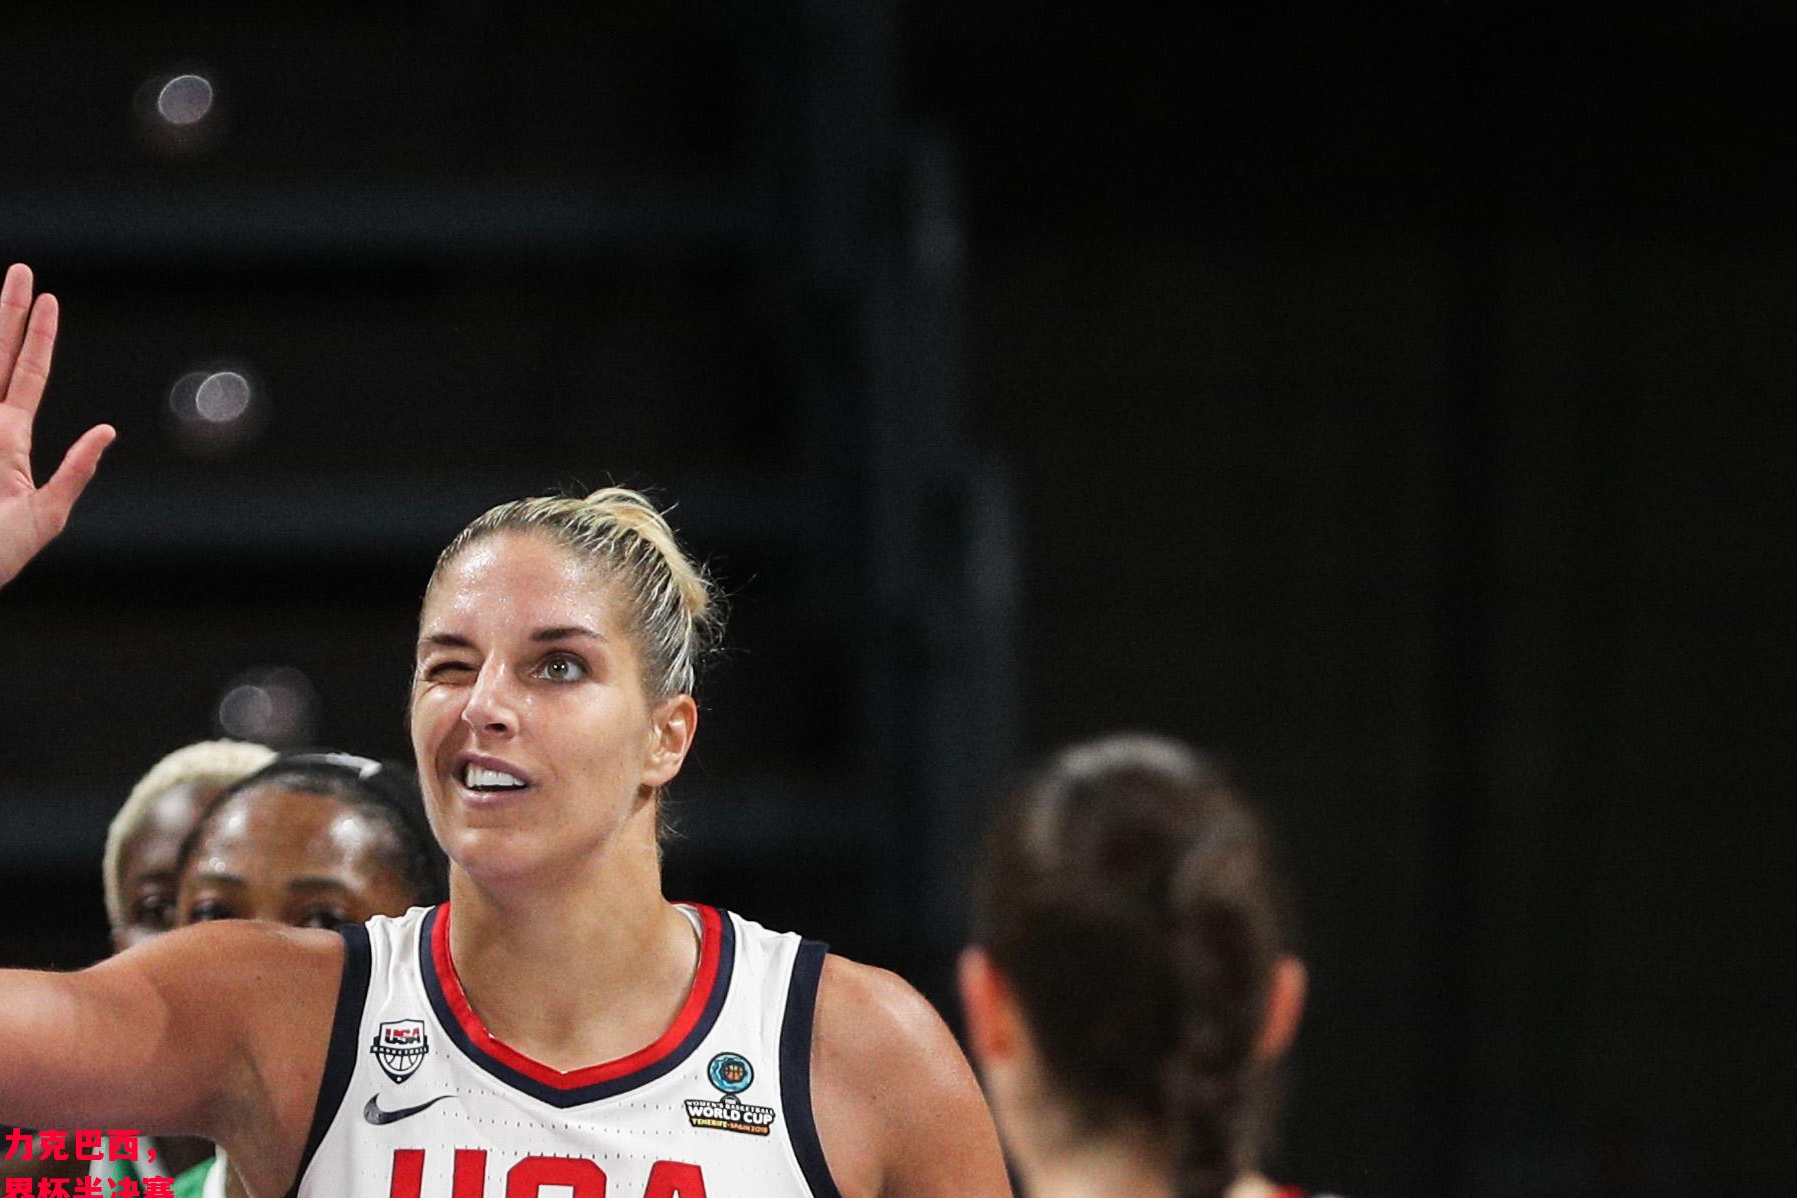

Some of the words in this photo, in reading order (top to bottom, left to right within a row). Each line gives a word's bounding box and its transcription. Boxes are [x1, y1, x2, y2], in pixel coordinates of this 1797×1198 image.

[385, 1028, 420, 1044] USA
[688, 1106, 740, 1120] WORLD
[743, 1112, 773, 1125] CUP
